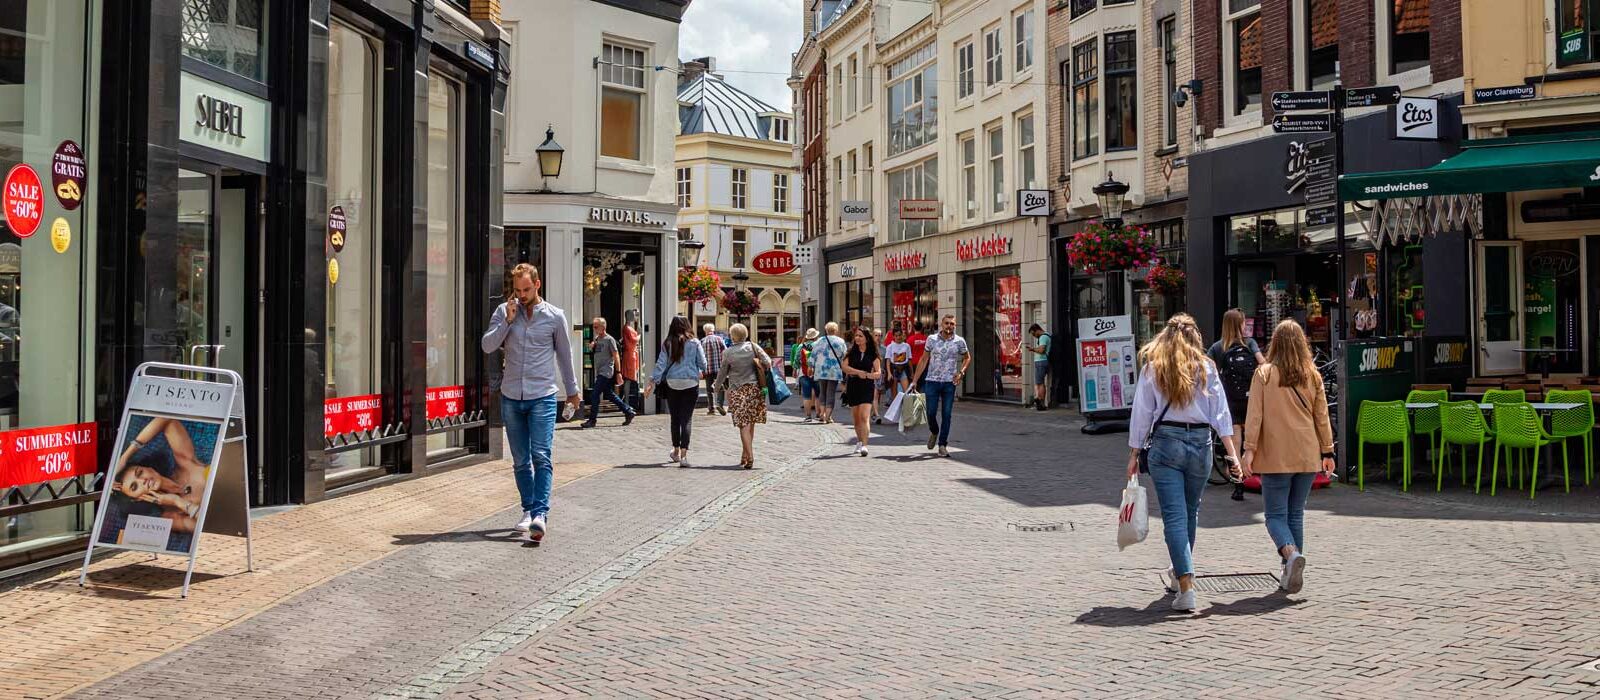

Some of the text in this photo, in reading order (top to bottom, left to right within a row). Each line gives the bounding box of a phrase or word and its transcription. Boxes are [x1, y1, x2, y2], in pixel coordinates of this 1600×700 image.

[1564, 38, 1581, 54] SUB
[1494, 87, 1534, 96] Clarenburg
[196, 94, 246, 138] SIEBEL
[1402, 103, 1433, 123] Etos
[55, 162, 84, 178] GRATIS
[10, 182, 38, 200] SALE
[1365, 182, 1429, 194] sandwiches
[1024, 193, 1047, 207] Etos
[13, 201, 38, 219] -60%
[844, 205, 868, 213] Gabor
[956, 232, 1006, 262] Foot Locker
[760, 256, 791, 269] SCORE
[884, 251, 922, 272] Foot Locker
[1001, 293, 1019, 309] SALE
[893, 304, 906, 319] SALE
[1001, 323, 1019, 340] HERE
[1094, 318, 1116, 331] Etos
[1084, 345, 1104, 356] 1+1
[1359, 345, 1400, 372] SUBWAY
[1434, 342, 1467, 364] SUBWAY
[145, 383, 221, 402] TI SENTO
[328, 402, 342, 413] SALE
[347, 398, 381, 411] SUMMER SALE
[16, 429, 91, 453] SUMMER SALE
[41, 451, 72, 474] -60%
